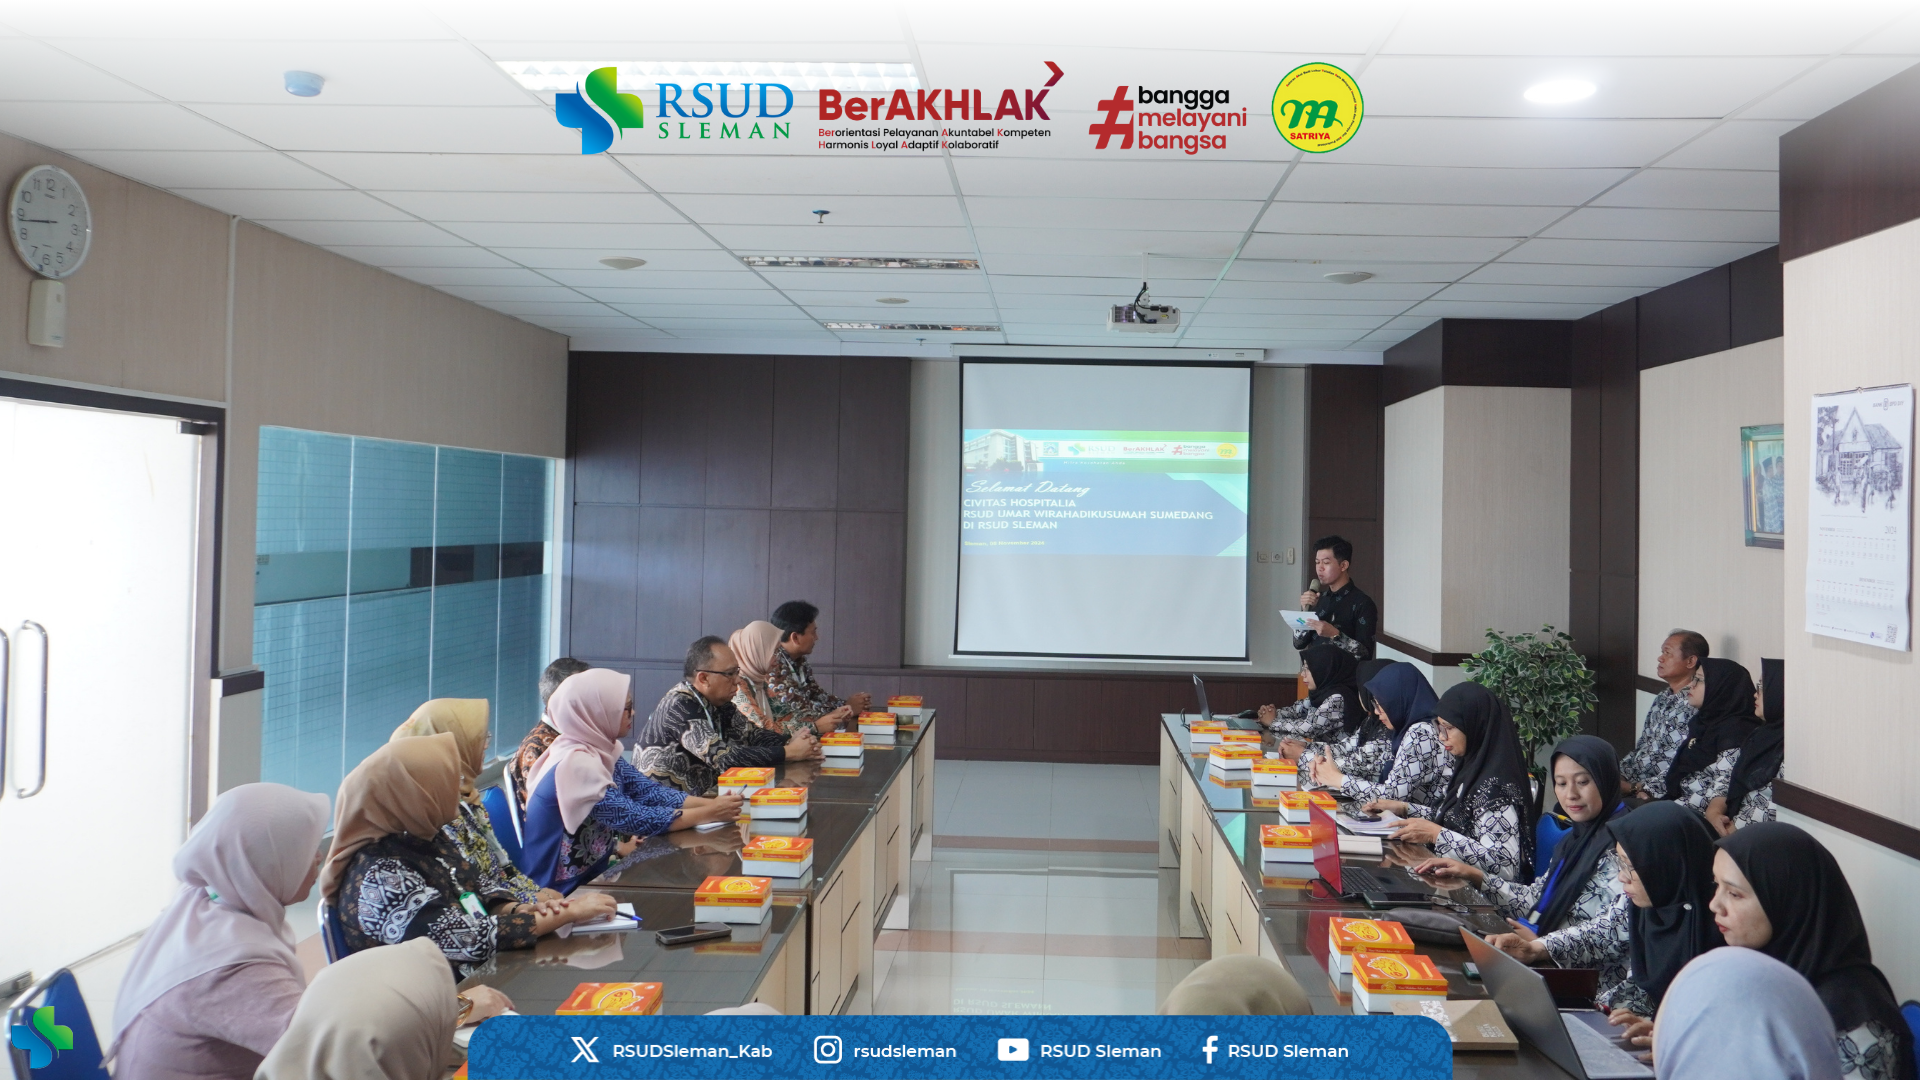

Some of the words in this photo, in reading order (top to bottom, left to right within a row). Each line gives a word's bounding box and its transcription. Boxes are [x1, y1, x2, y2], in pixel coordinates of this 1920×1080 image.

[46, 178, 55, 191] 12
[21, 190, 32, 203] 10
[68, 204, 76, 216] 2
[20, 228, 28, 240] 8
[70, 223, 78, 235] 3
[31, 245, 39, 257] 7
[66, 241, 74, 252] 4
[42, 253, 50, 265] 6
[56, 251, 64, 264] 5
[965, 480, 1032, 494] Selamat
[1034, 481, 1091, 497] Datang
[964, 499, 1007, 507] CIVITAS
[1010, 499, 1077, 508] HOSPITALIA
[964, 510, 994, 518] RSUD
[998, 509, 1031, 518] UMAR
[1034, 509, 1147, 519] WIRAHADIKUSUMAH
[1150, 511, 1214, 520] SUMEDANG
[964, 521, 974, 530] DI
[978, 521, 1009, 530] RSUD
[1012, 521, 1058, 530] SLEMAN
